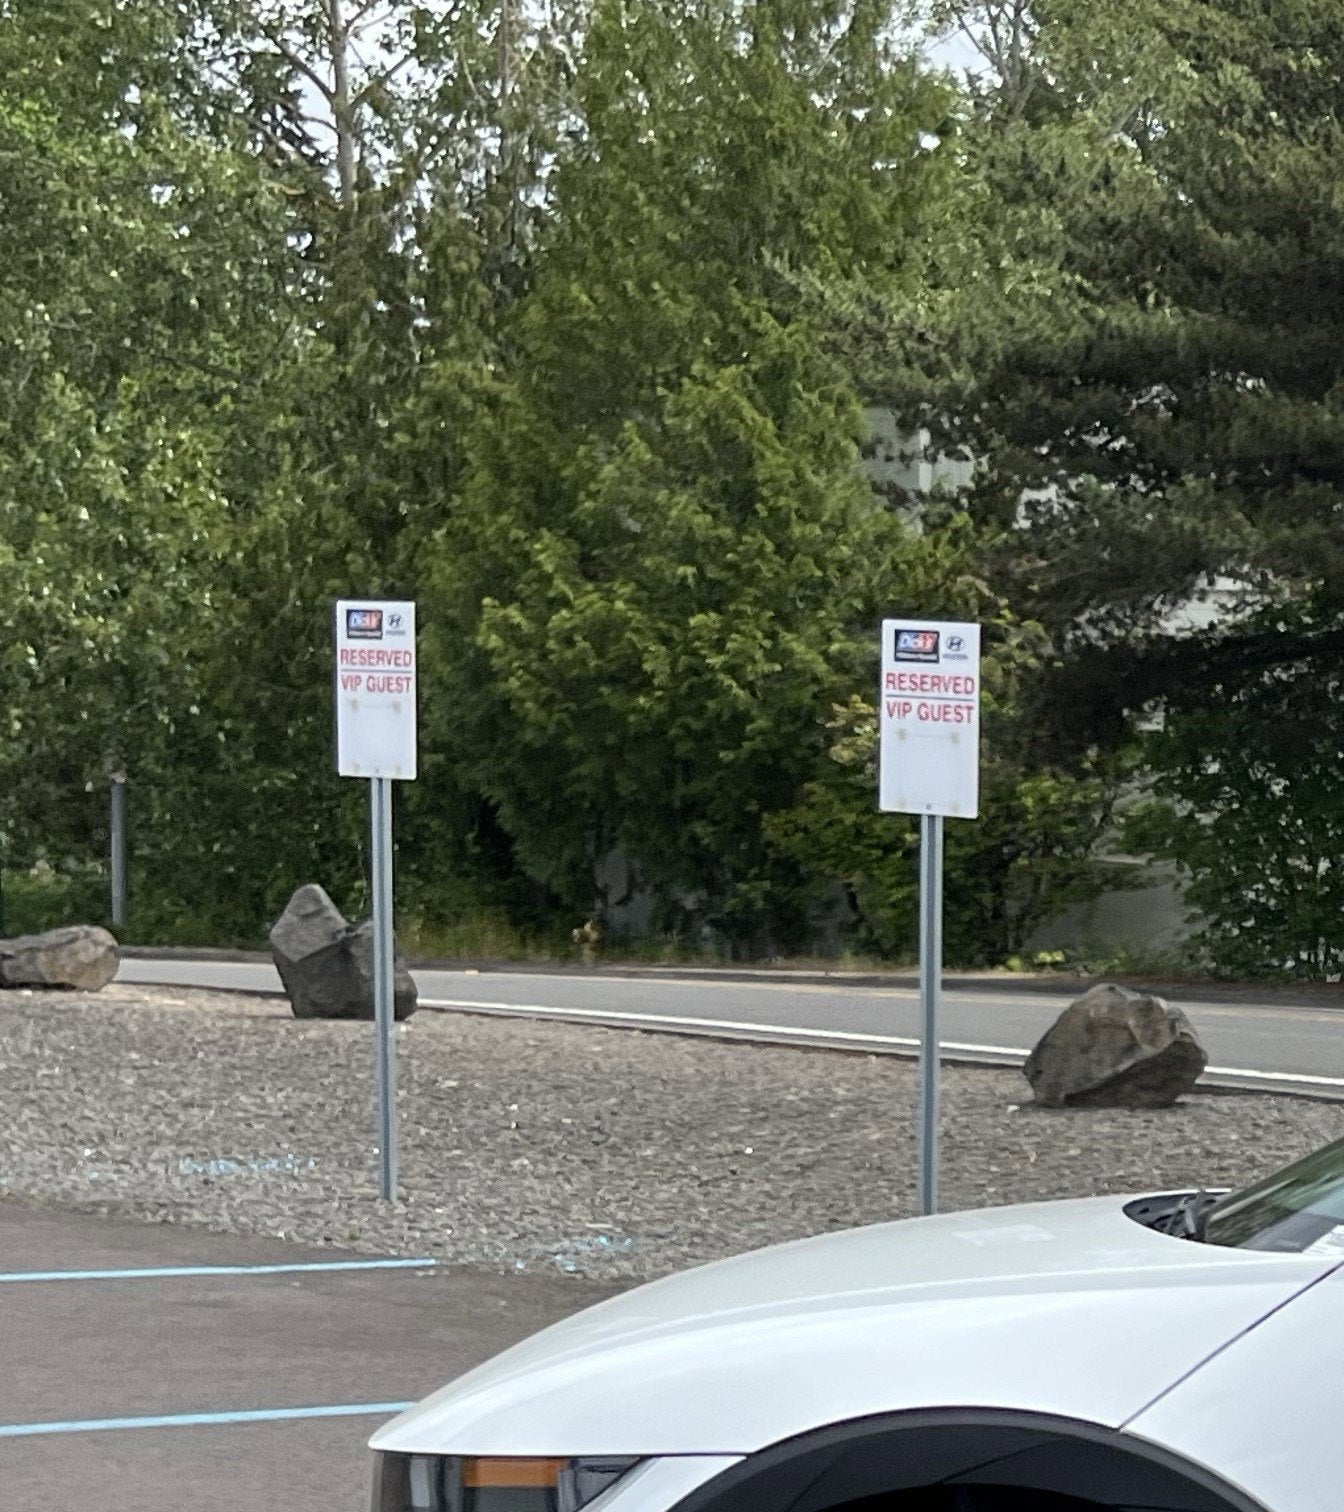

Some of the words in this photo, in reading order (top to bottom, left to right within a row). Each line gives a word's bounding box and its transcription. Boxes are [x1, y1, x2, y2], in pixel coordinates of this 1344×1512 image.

[340, 648, 412, 667] RESERVED
[341, 675, 361, 691] VIP
[366, 675, 412, 693] GUEST
[885, 672, 975, 695] RESERVED
[886, 701, 912, 720] VIP
[917, 702, 974, 724] GUEST
